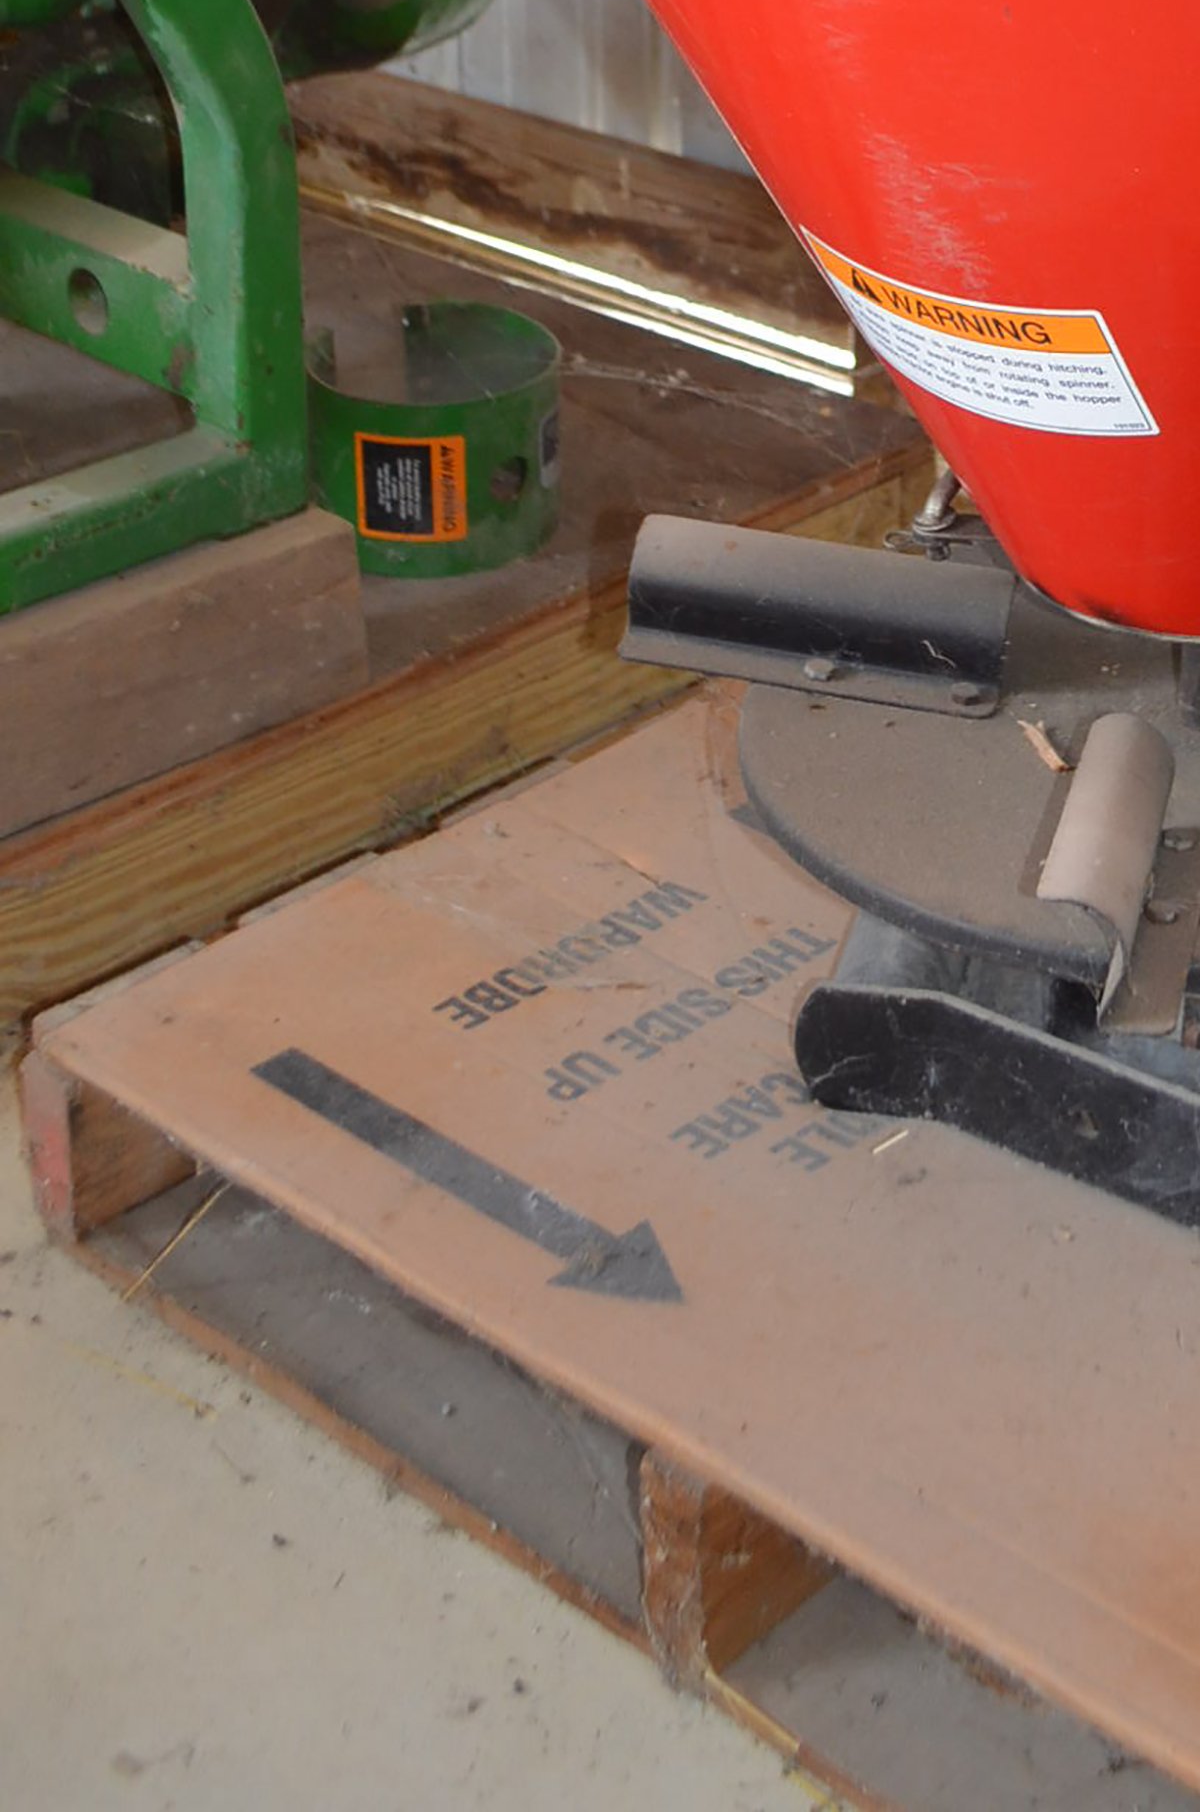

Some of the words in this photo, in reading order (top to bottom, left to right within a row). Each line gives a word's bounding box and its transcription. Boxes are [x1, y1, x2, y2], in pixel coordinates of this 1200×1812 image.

[881, 285, 1053, 345] WARNING
[946, 344, 996, 364] stopped
[1001, 357, 1043, 373] during
[998, 371, 1051, 387] rotating
[1001, 385, 1040, 399] inside
[1044, 390, 1067, 401] the
[1072, 393, 1122, 405] hopper
[431, 880, 709, 1031] WARDROBE
[714, 927, 838, 998] THIS
[603, 987, 734, 1061] SIDE
[544, 1049, 623, 1102] UP
[667, 1071, 813, 1161] CARE
